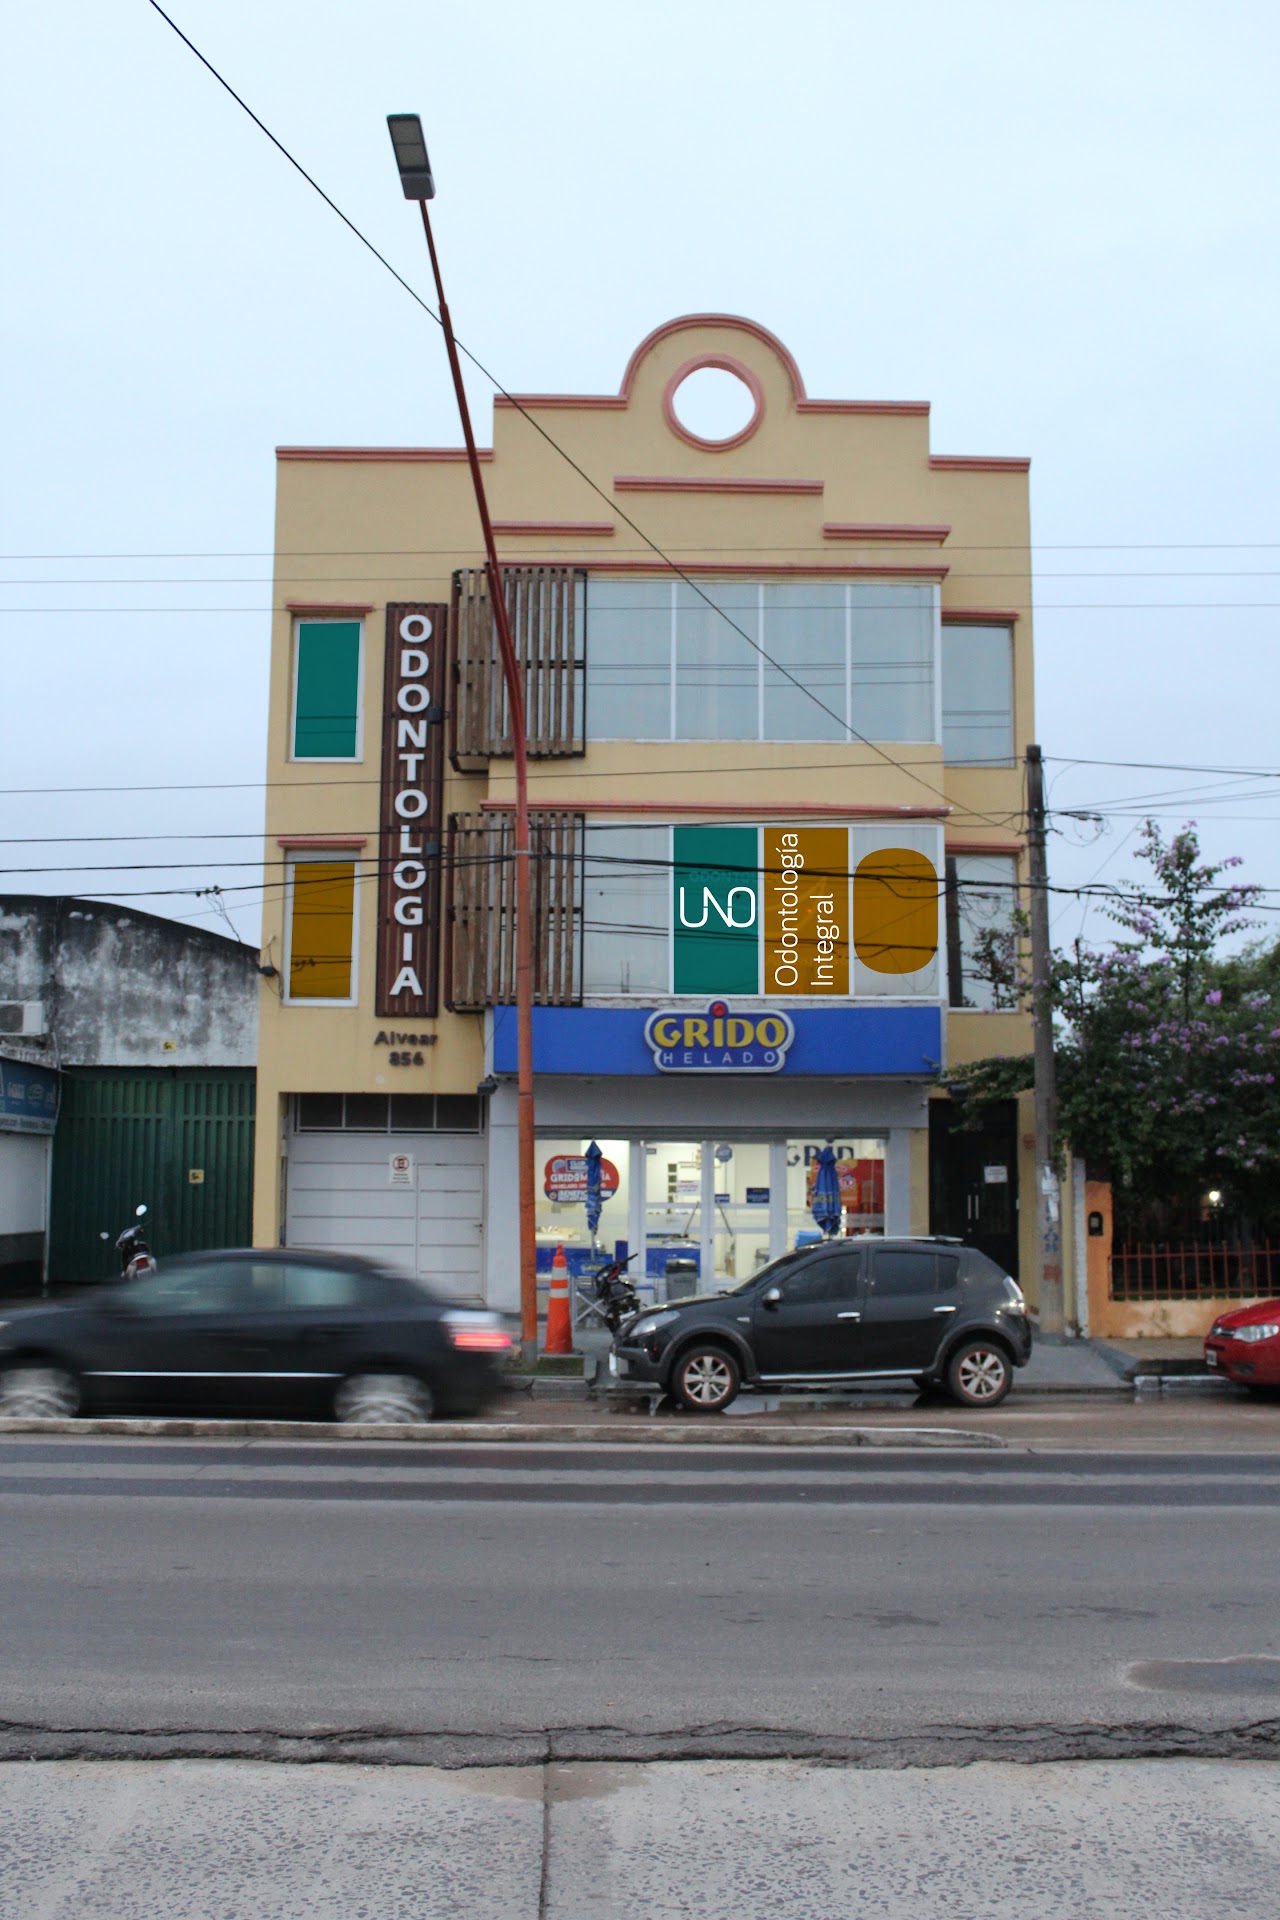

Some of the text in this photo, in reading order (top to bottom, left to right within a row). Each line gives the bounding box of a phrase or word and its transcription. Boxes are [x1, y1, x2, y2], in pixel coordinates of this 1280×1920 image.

[388, 614, 433, 996] ODONTOLOGIA
[679, 886, 756, 928] UNO
[773, 833, 804, 987] Odontología
[809, 893, 840, 986] Integral
[373, 1030, 439, 1046] Alvear
[653, 1017, 786, 1048] GRIDO
[388, 1051, 425, 1067] 856
[662, 1052, 777, 1064] HELADO
